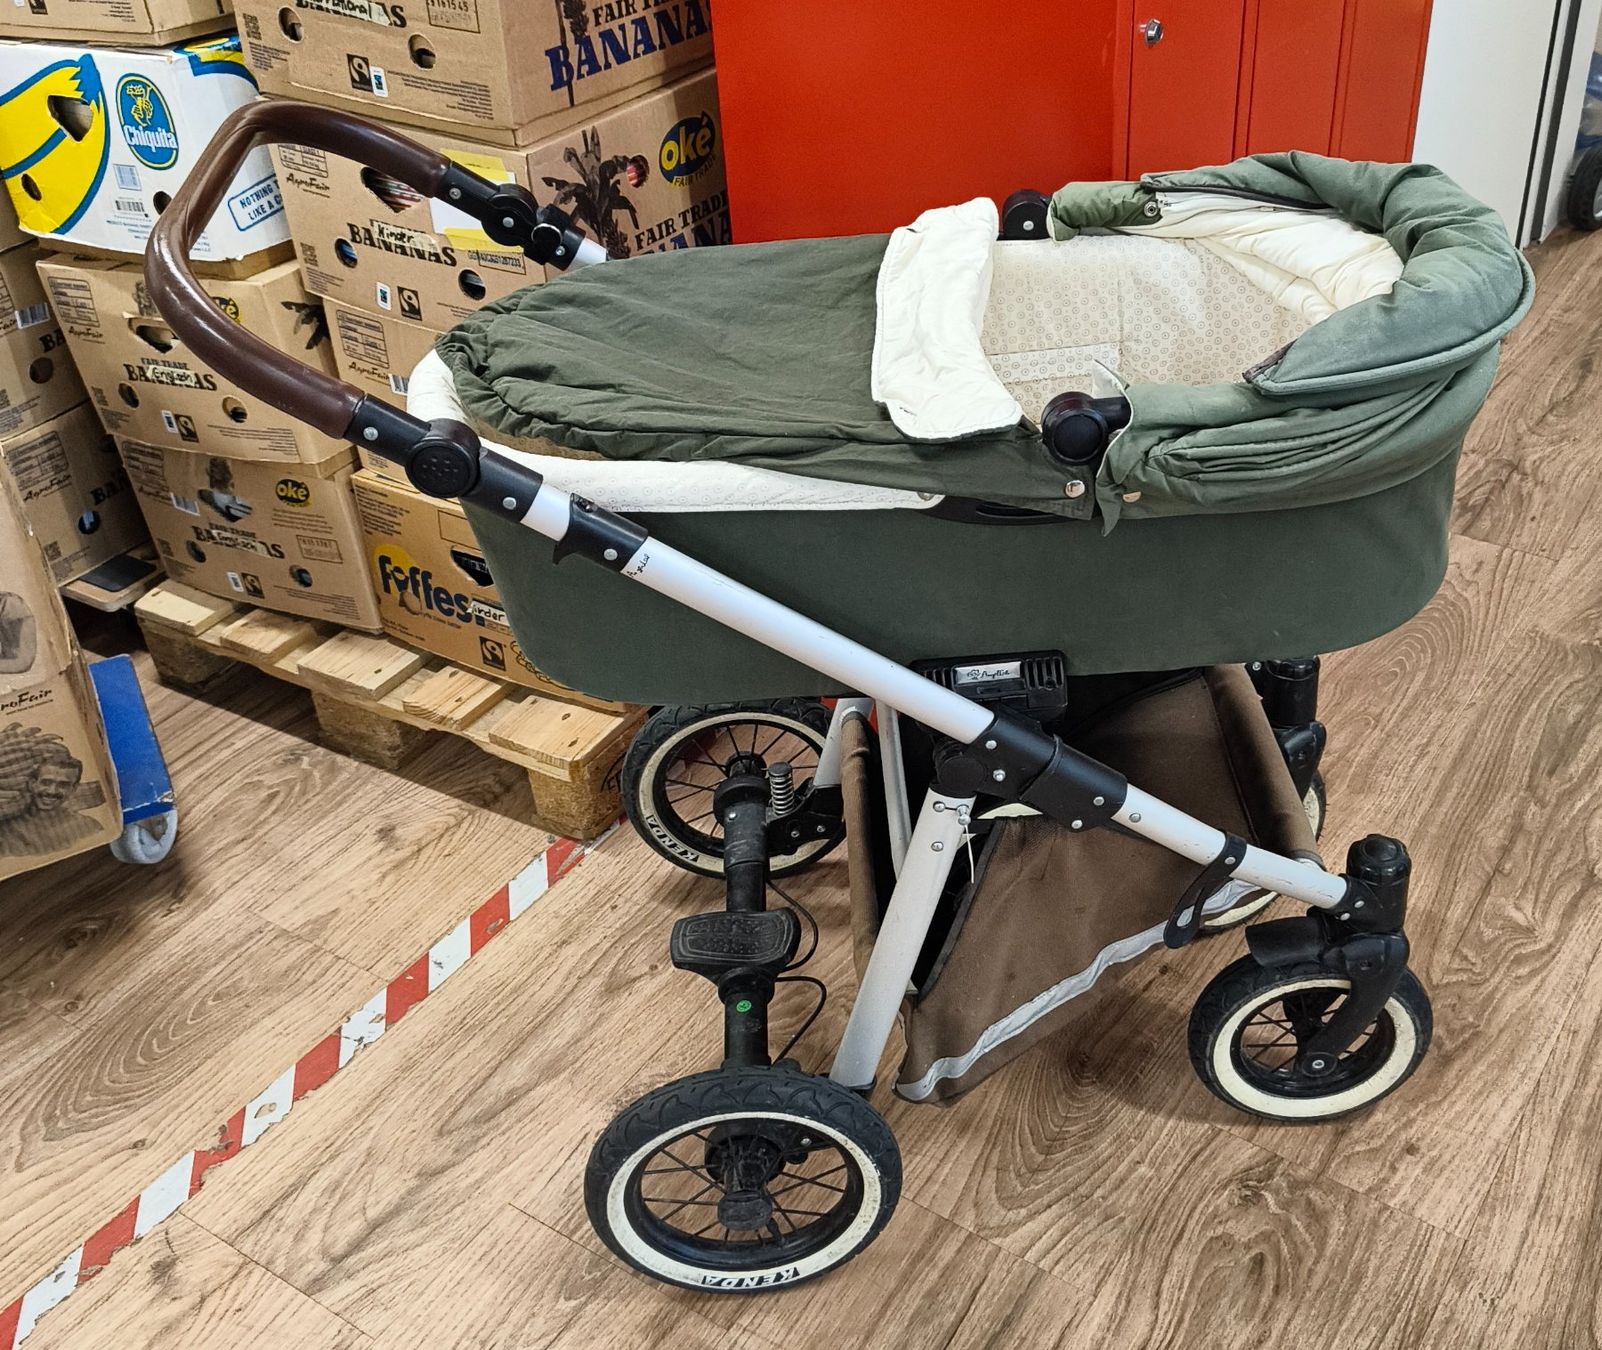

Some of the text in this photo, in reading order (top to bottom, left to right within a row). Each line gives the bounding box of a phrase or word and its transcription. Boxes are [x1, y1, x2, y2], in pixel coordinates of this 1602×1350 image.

[545, 0, 712, 91] BANANA
[123, 125, 178, 152] Chiquita
[661, 115, 713, 171] oké
[239, 185, 274, 210] NOTHING
[248, 202, 267, 221] LIKE
[634, 217, 677, 250] FAIR
[277, 480, 309, 501] oké
[1, 690, 52, 711] roFair
[647, 814, 701, 863] KENDA
[702, 1266, 801, 1289] KENDA
